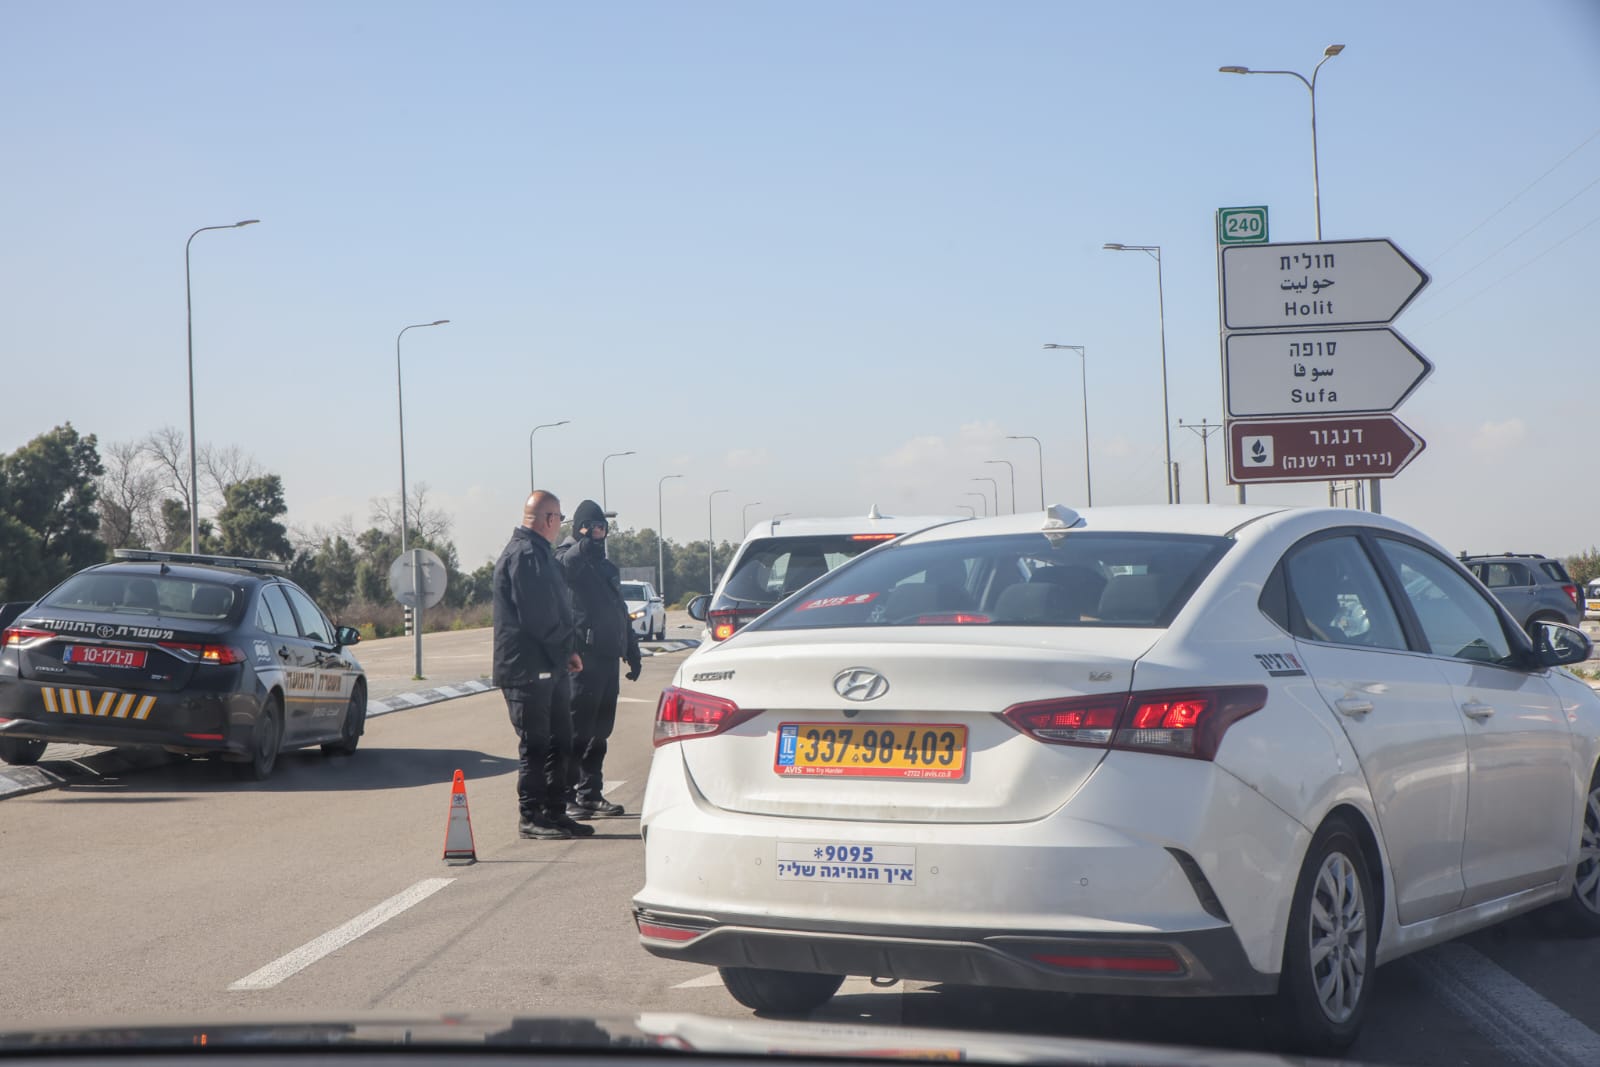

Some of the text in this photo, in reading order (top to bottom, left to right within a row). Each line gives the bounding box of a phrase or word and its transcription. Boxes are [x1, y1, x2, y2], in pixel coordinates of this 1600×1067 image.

[1229, 218, 1260, 232] 240
[1280, 253, 1335, 270] חולית
[1280, 276, 1335, 294] حوليت
[1285, 301, 1333, 316] Holit
[1290, 342, 1336, 357] סופה
[1291, 389, 1337, 403] Sufa
[1310, 429, 1363, 445] דנגור
[1282, 452, 1392, 470] (נירים הישנה)
[44, 619, 174, 640] משטרת התנועה
[784, 766, 802, 774] AVIS
[778, 862, 913, 883] איך הנהיגה שלי?
